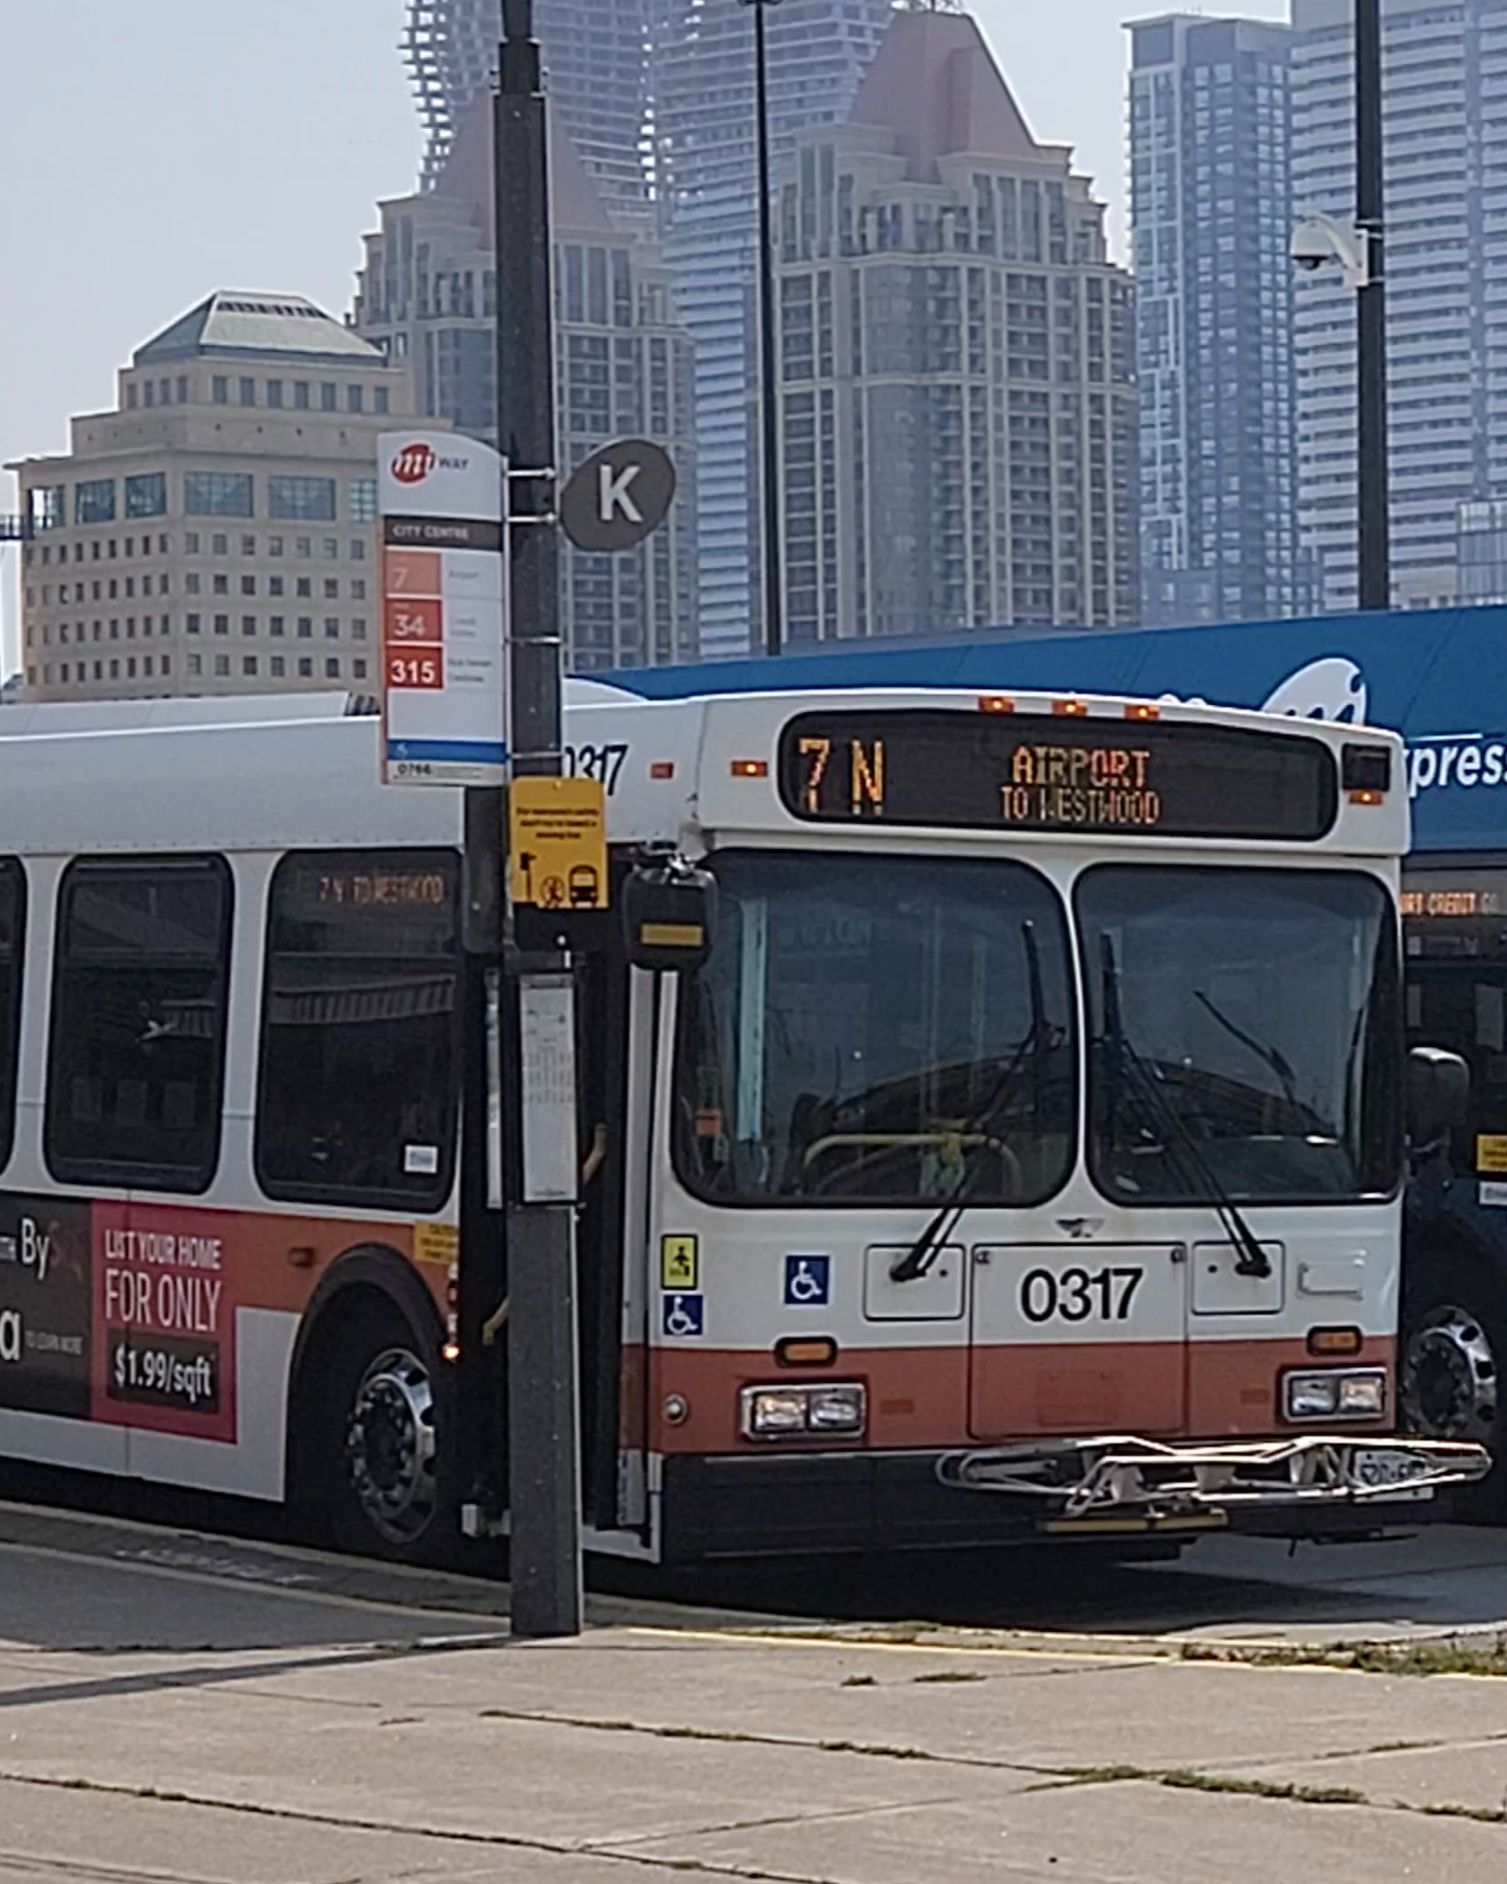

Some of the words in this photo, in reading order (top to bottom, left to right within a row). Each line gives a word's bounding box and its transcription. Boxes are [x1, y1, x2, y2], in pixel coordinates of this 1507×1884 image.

[599, 464, 643, 522] K
[393, 524, 421, 538] CITY
[393, 567, 408, 590] 7
[394, 614, 426, 637] 34
[391, 660, 435, 684] 315
[799, 737, 831, 814] 7
[851, 739, 883, 816] N
[1012, 746, 1150, 788] AIRPORT
[1001, 786, 1029, 820] TO
[22, 1217, 49, 1280] By
[105, 1230, 136, 1261] LIST
[137, 1232, 175, 1265] YOUR
[178, 1236, 221, 1270] HOME
[105, 1267, 152, 1325] FOR
[157, 1273, 221, 1332] ONLY
[1021, 1268, 1143, 1323] 0317
